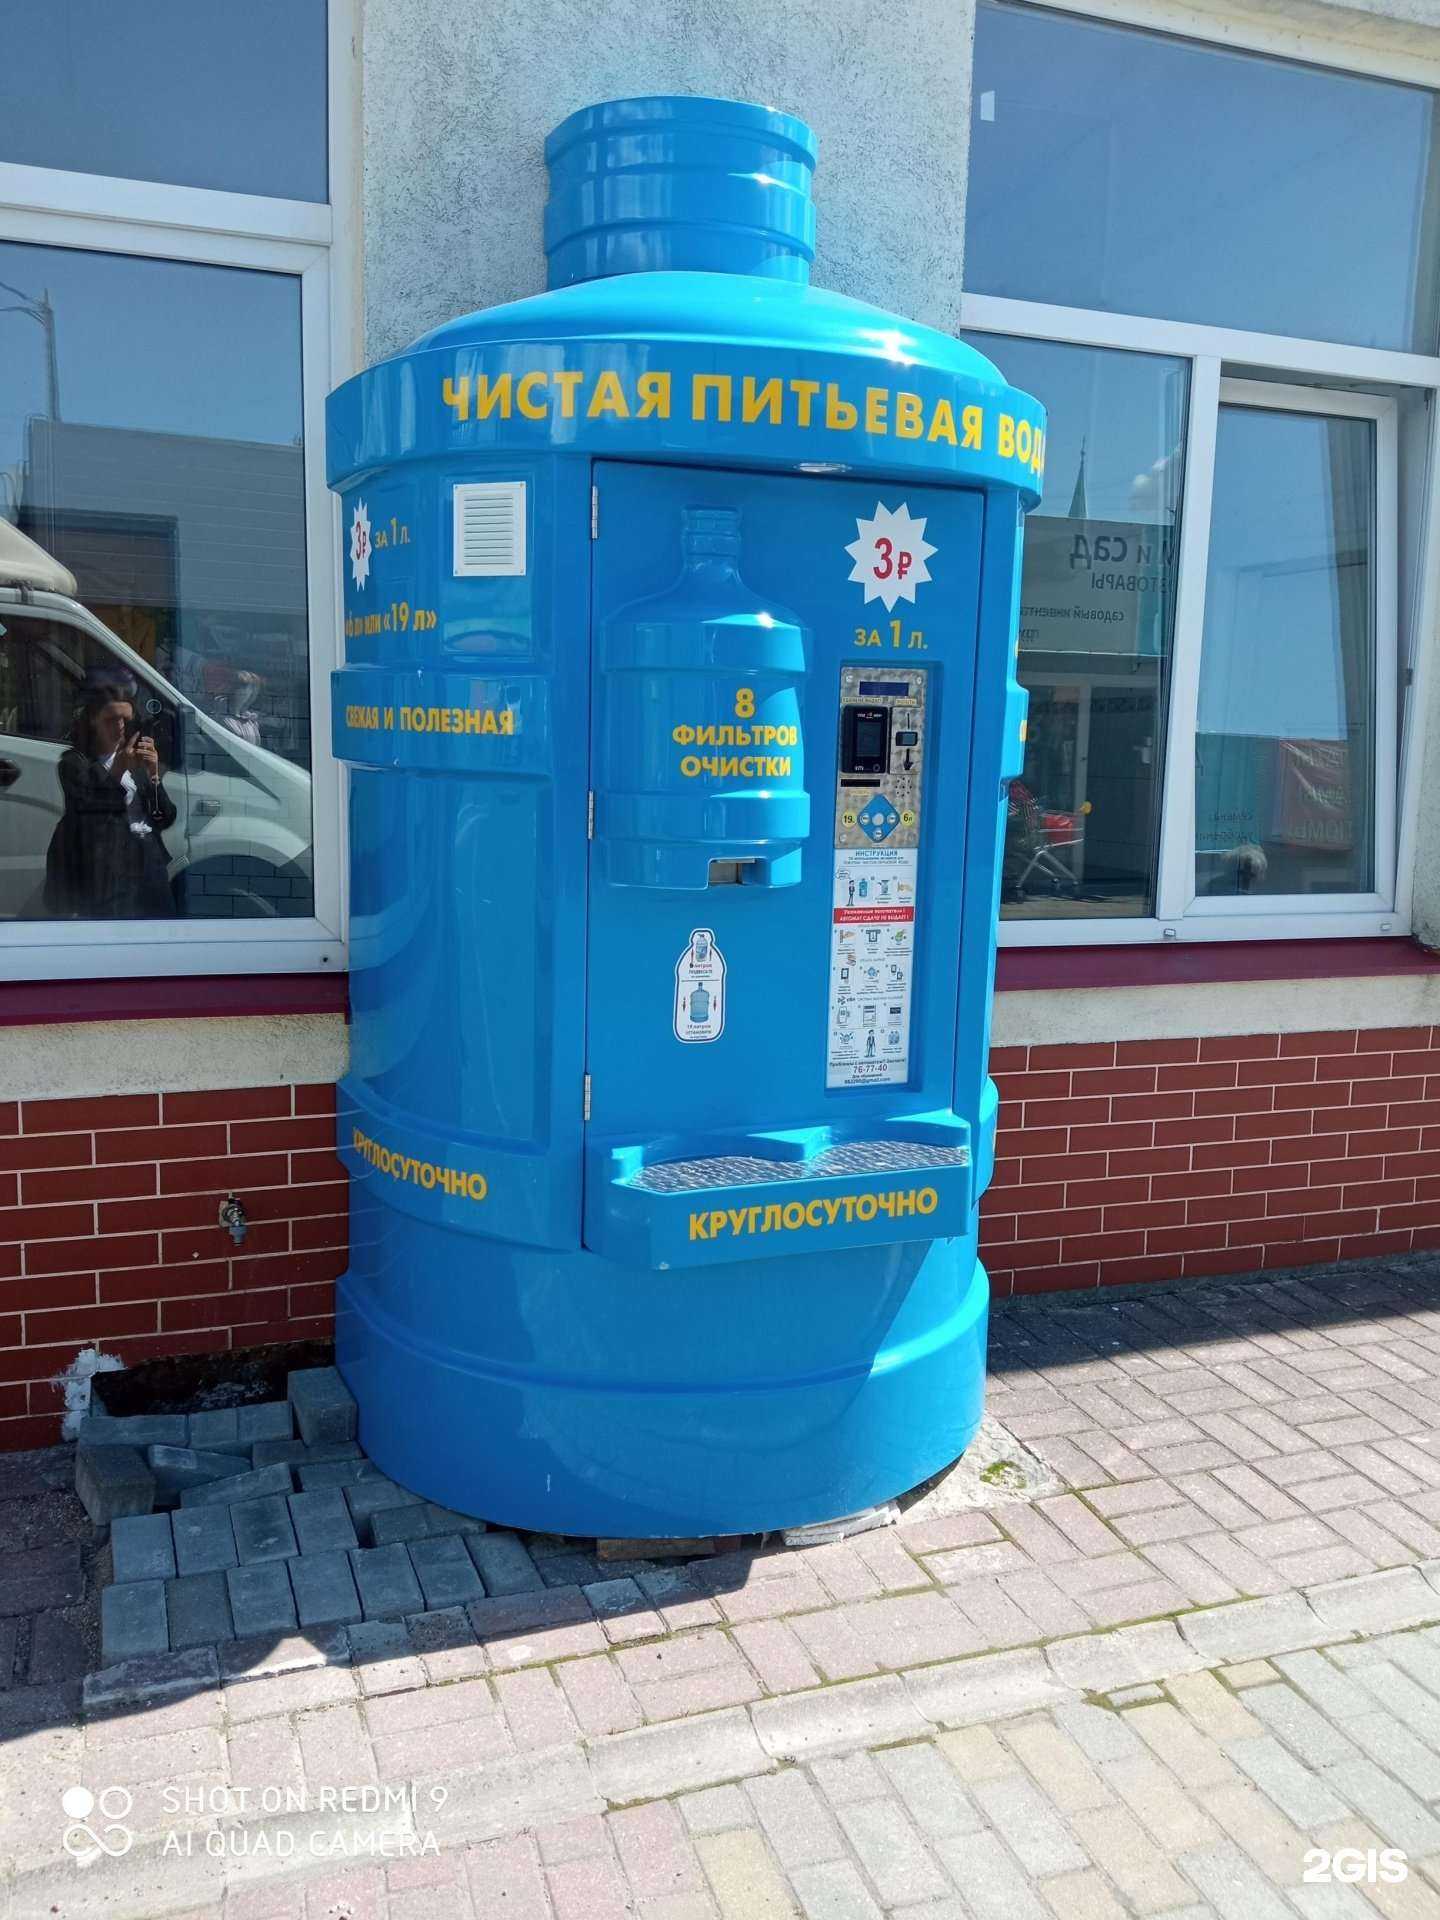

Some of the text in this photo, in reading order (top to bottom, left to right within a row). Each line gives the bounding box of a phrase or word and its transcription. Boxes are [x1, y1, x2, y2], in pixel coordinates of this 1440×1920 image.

[442, 371, 1045, 478] ЧИСТАЯ ПИТЬЕВАЯ ВОД
[391, 517, 397, 545] 1
[854, 628, 882, 647] ЗА
[890, 620, 901, 648] 1
[735, 688, 755, 718] 8
[384, 707, 394, 731] И
[400, 707, 514, 735] ПОЛЕЗНАЯ
[672, 724, 798, 746] ФИЛЬТРОВ
[680, 755, 791, 777] ОЧИСТКИ
[689, 1187, 938, 1240] КРУГЛОСУТОЧНО
